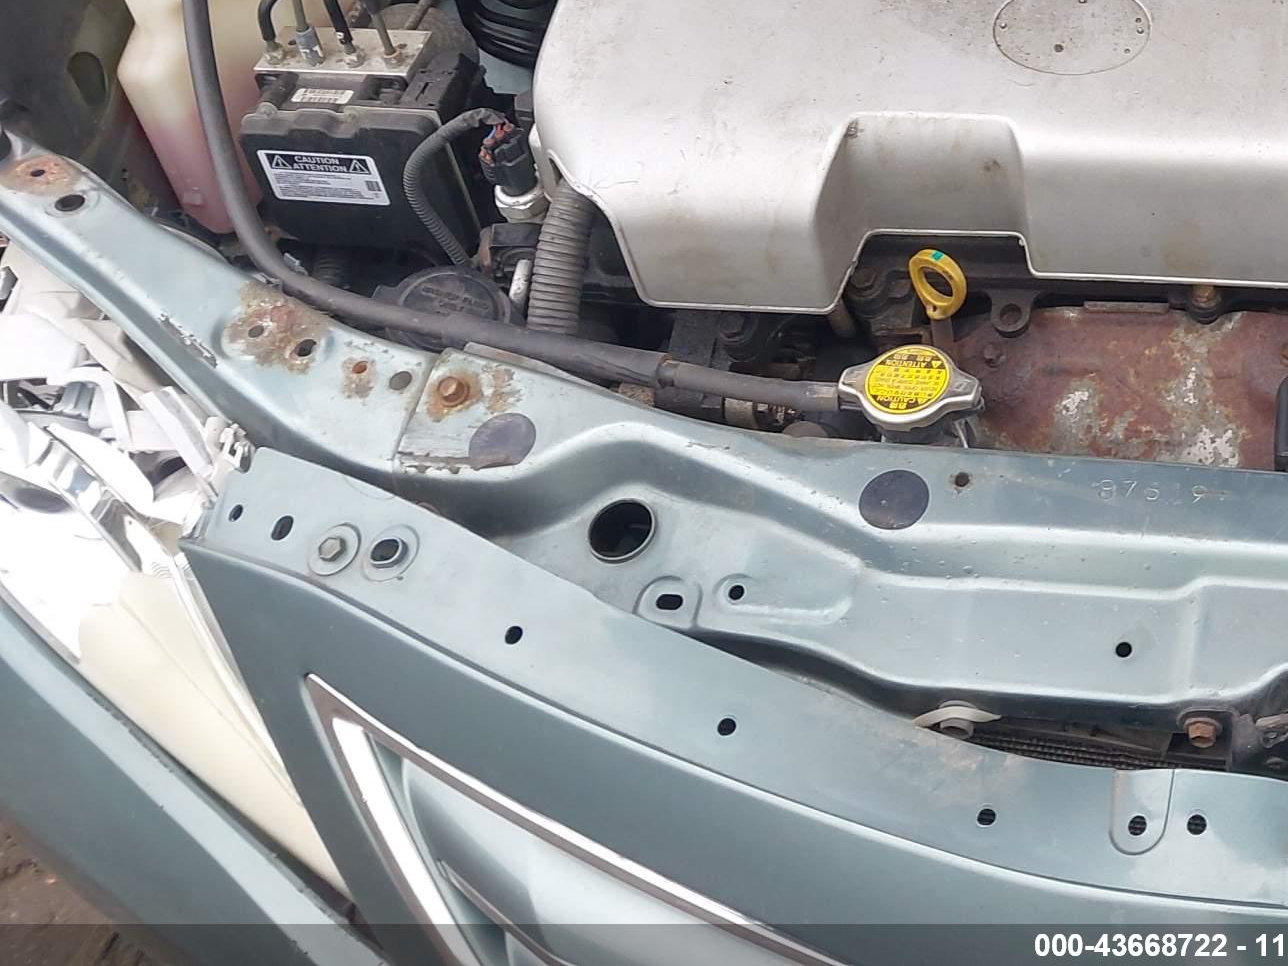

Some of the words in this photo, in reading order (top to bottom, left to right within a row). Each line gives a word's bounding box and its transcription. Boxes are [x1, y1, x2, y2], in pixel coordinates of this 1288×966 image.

[294, 155, 340, 165] CAUTION
[293, 163, 348, 172] ATTENTION
[884, 359, 927, 368] ATTENTION
[876, 395, 916, 404] CAUTION
